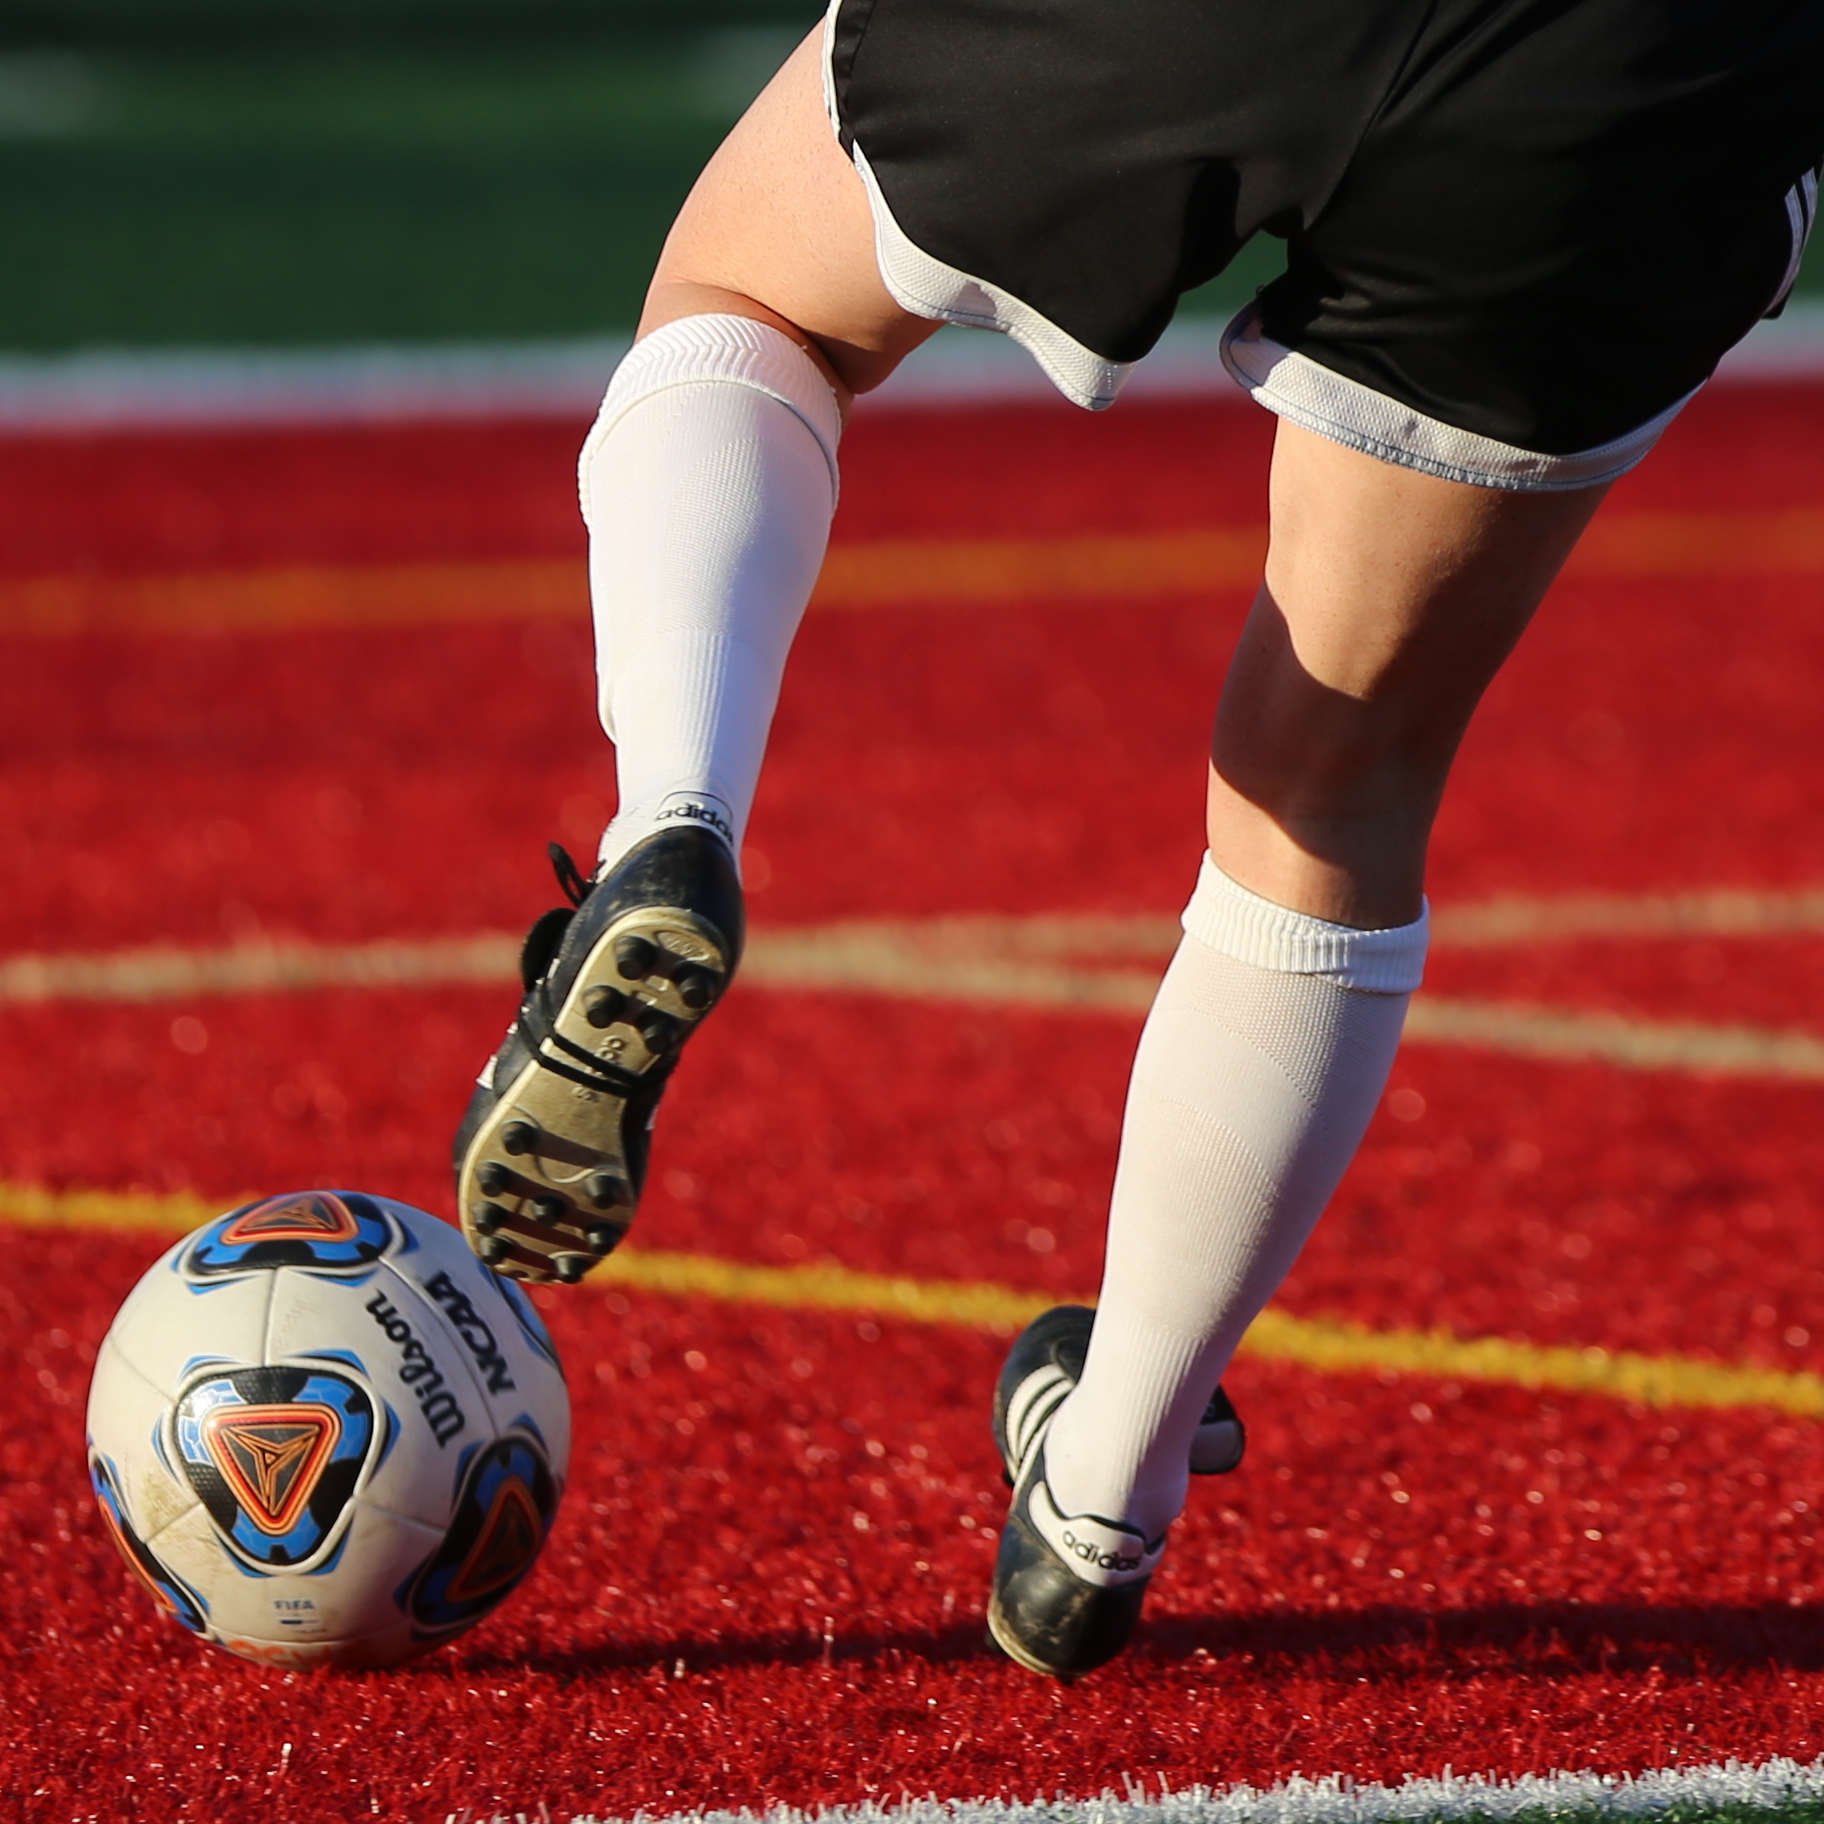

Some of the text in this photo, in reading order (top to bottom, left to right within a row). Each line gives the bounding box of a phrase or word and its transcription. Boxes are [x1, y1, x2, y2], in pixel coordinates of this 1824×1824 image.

[365, 1289, 466, 1450] Wilson
[423, 1269, 516, 1397] NCAA
[1062, 1530, 1141, 1572] adidas
[274, 1599, 316, 1611] FIFA
